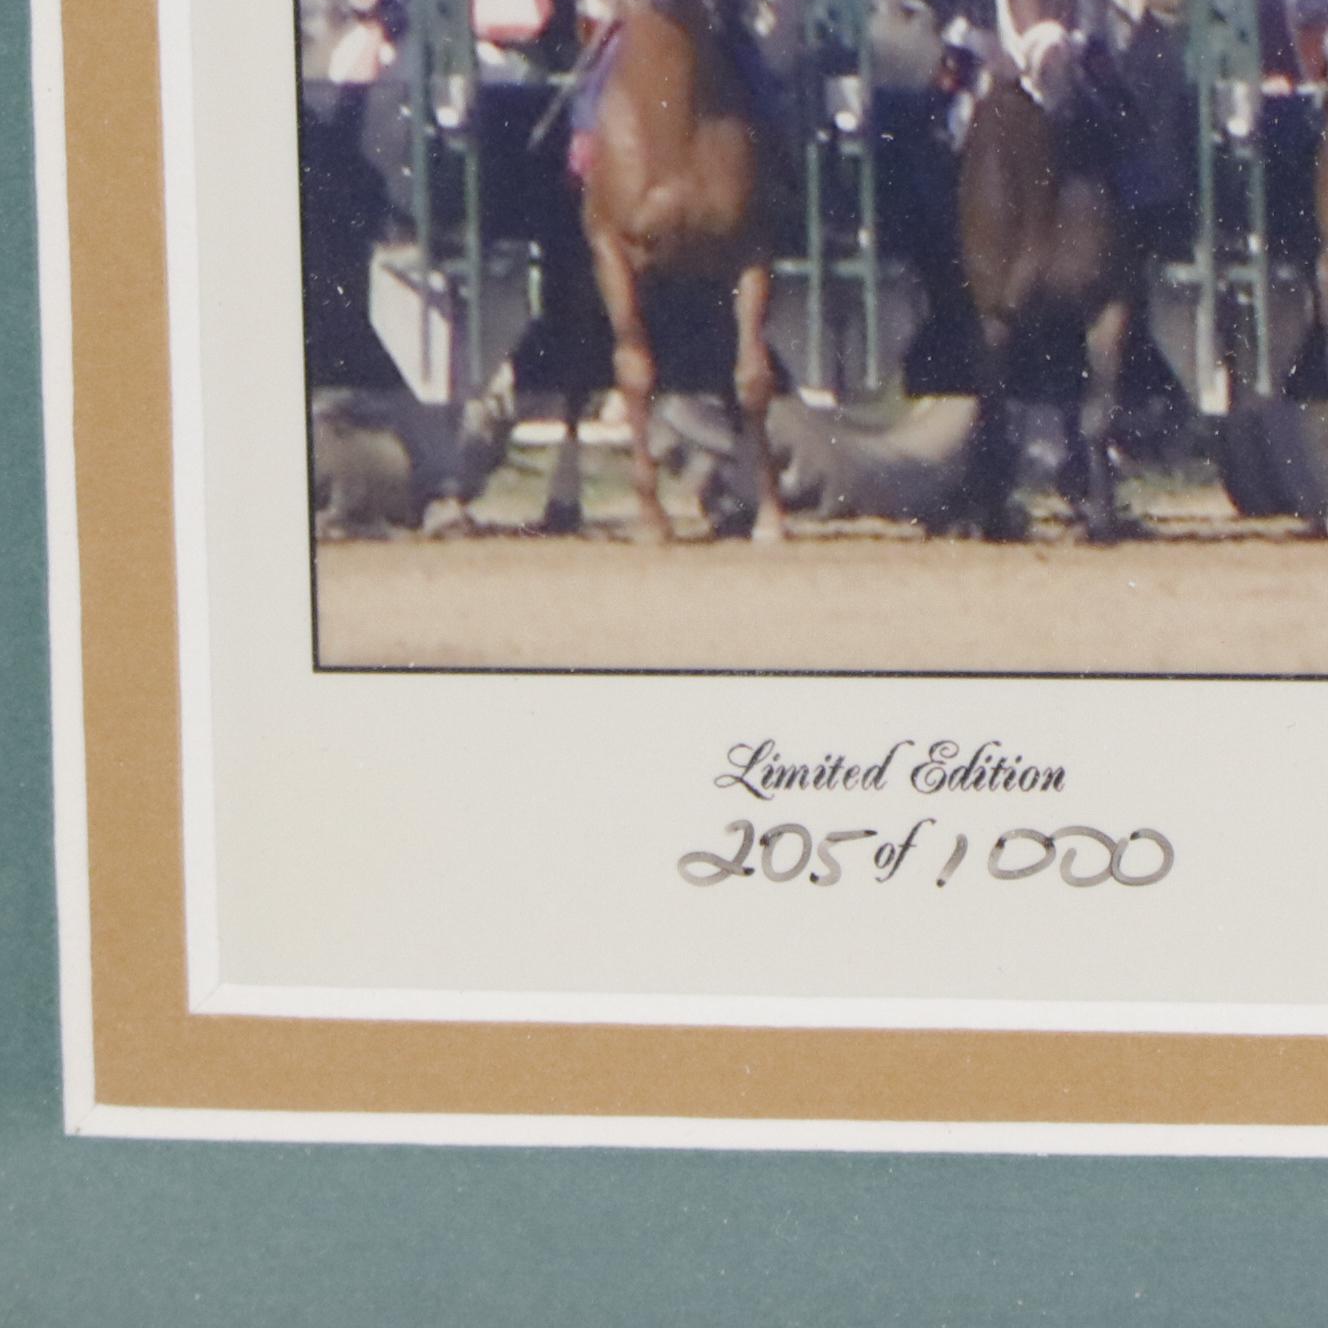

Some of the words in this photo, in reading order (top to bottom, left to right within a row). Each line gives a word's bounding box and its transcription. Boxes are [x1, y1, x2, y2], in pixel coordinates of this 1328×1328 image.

[713, 739, 914, 800] Limited
[910, 739, 1066, 793] Edition
[677, 819, 878, 887] 205
[874, 818, 935, 882] of
